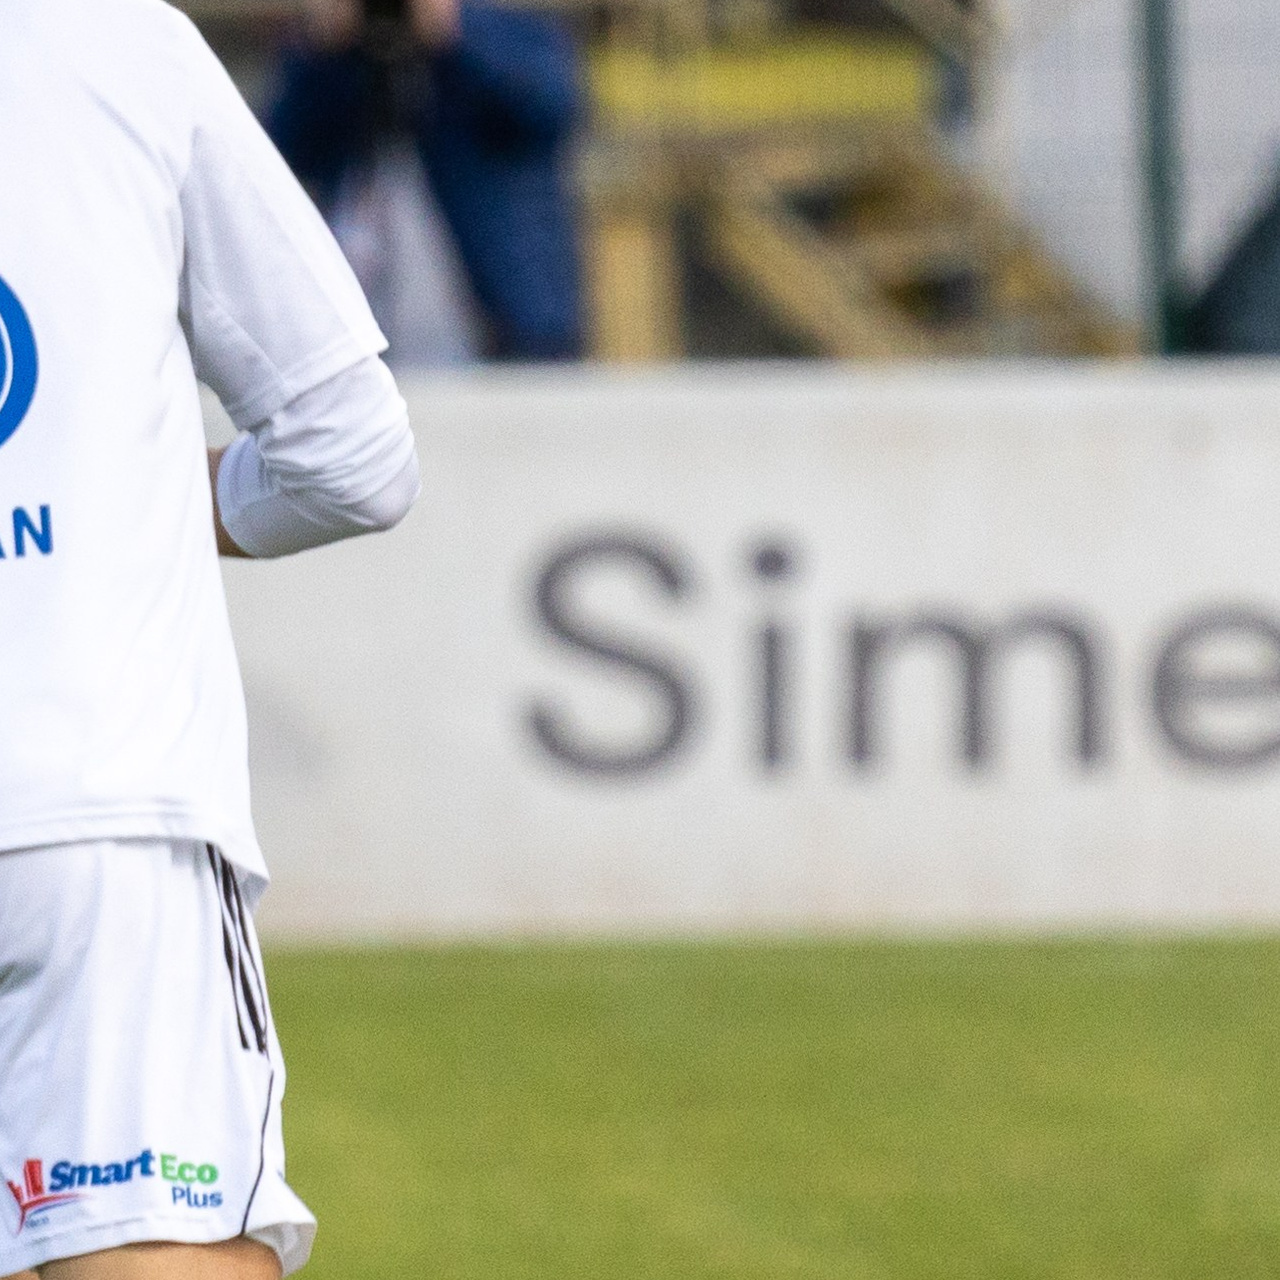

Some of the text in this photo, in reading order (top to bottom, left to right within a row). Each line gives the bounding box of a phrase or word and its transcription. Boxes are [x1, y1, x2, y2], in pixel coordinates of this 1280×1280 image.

[524, 526, 1280, 780] Sime
[48, 1149, 218, 1192] Smart Eco
[172, 1186, 223, 1208] Plus
